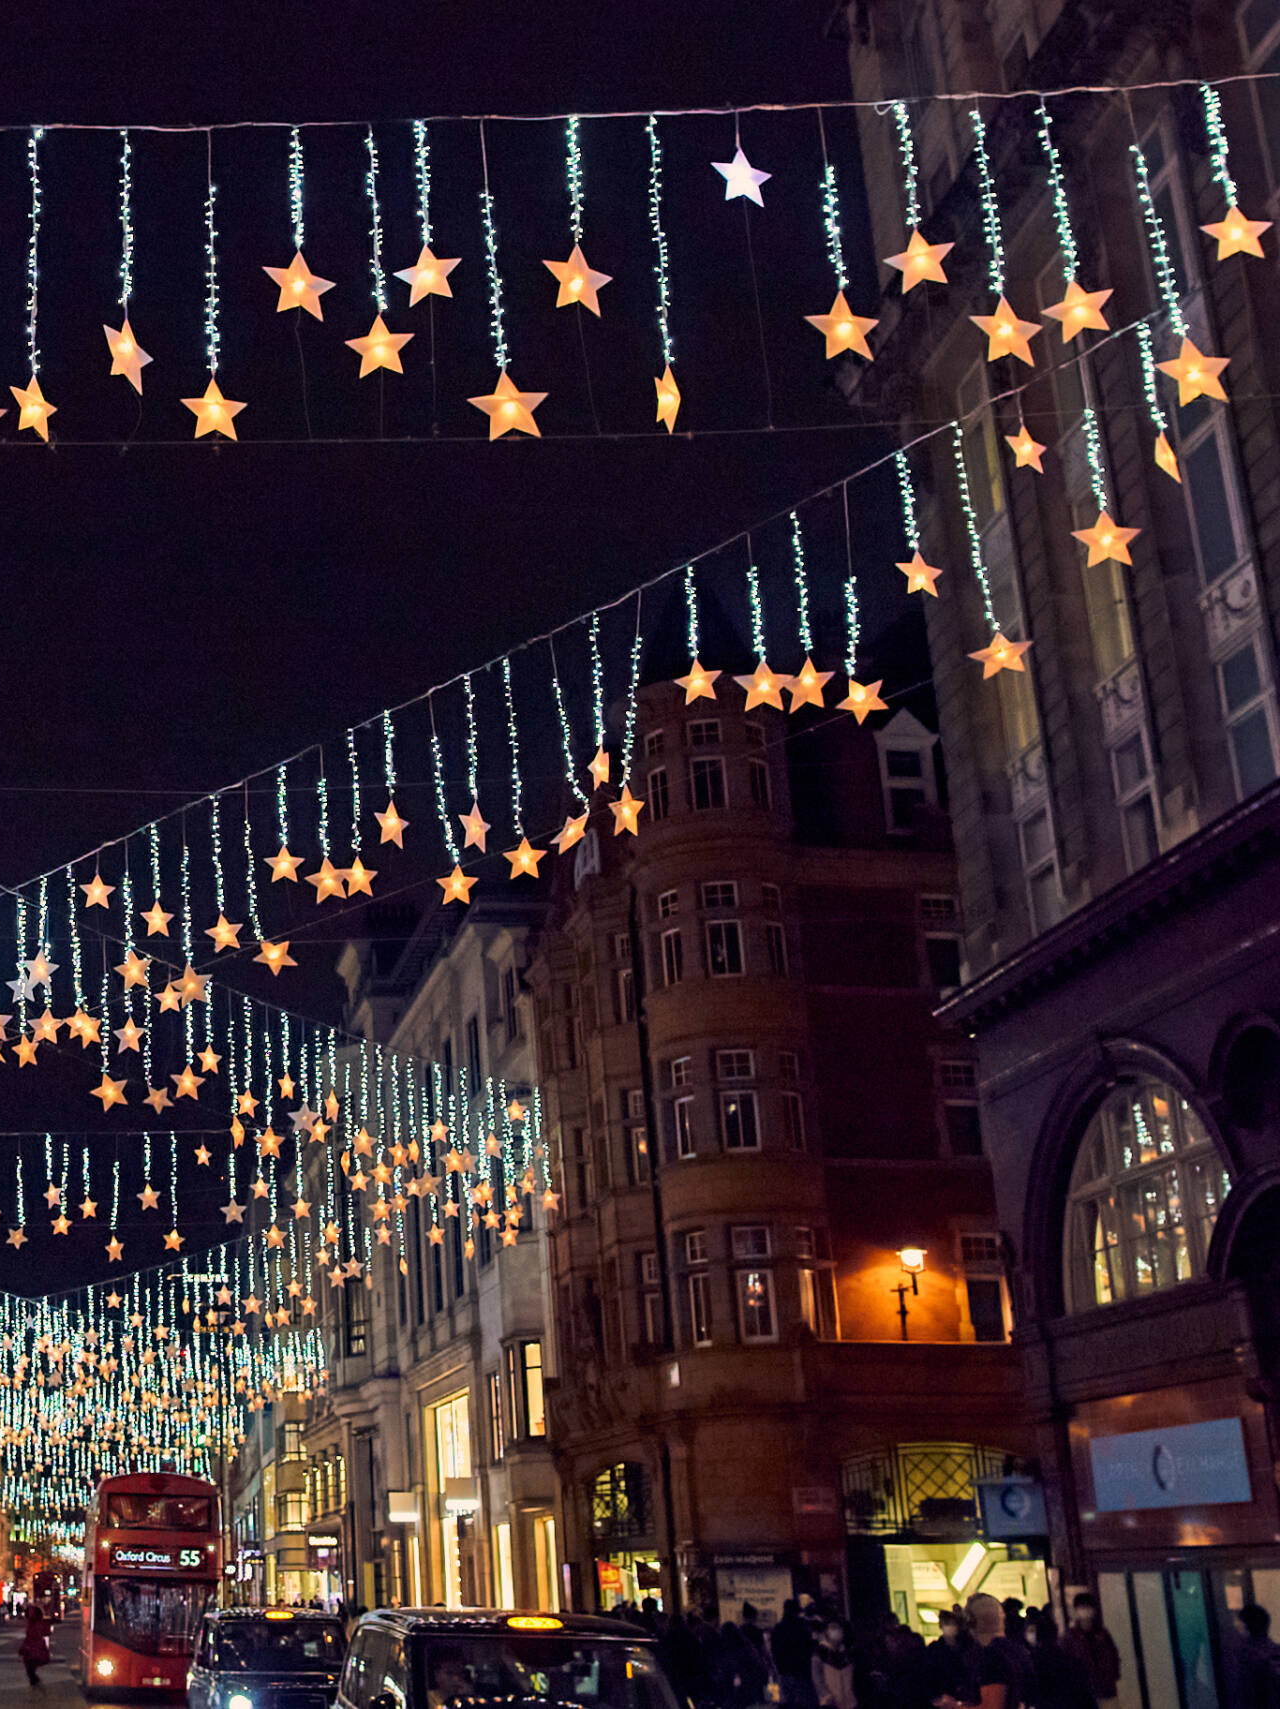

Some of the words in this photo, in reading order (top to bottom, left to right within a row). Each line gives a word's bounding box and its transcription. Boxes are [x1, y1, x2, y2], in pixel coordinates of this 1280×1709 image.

[115, 1550, 144, 1562] Oxford
[145, 1551, 171, 1563] Circus
[179, 1550, 200, 1567] 55
